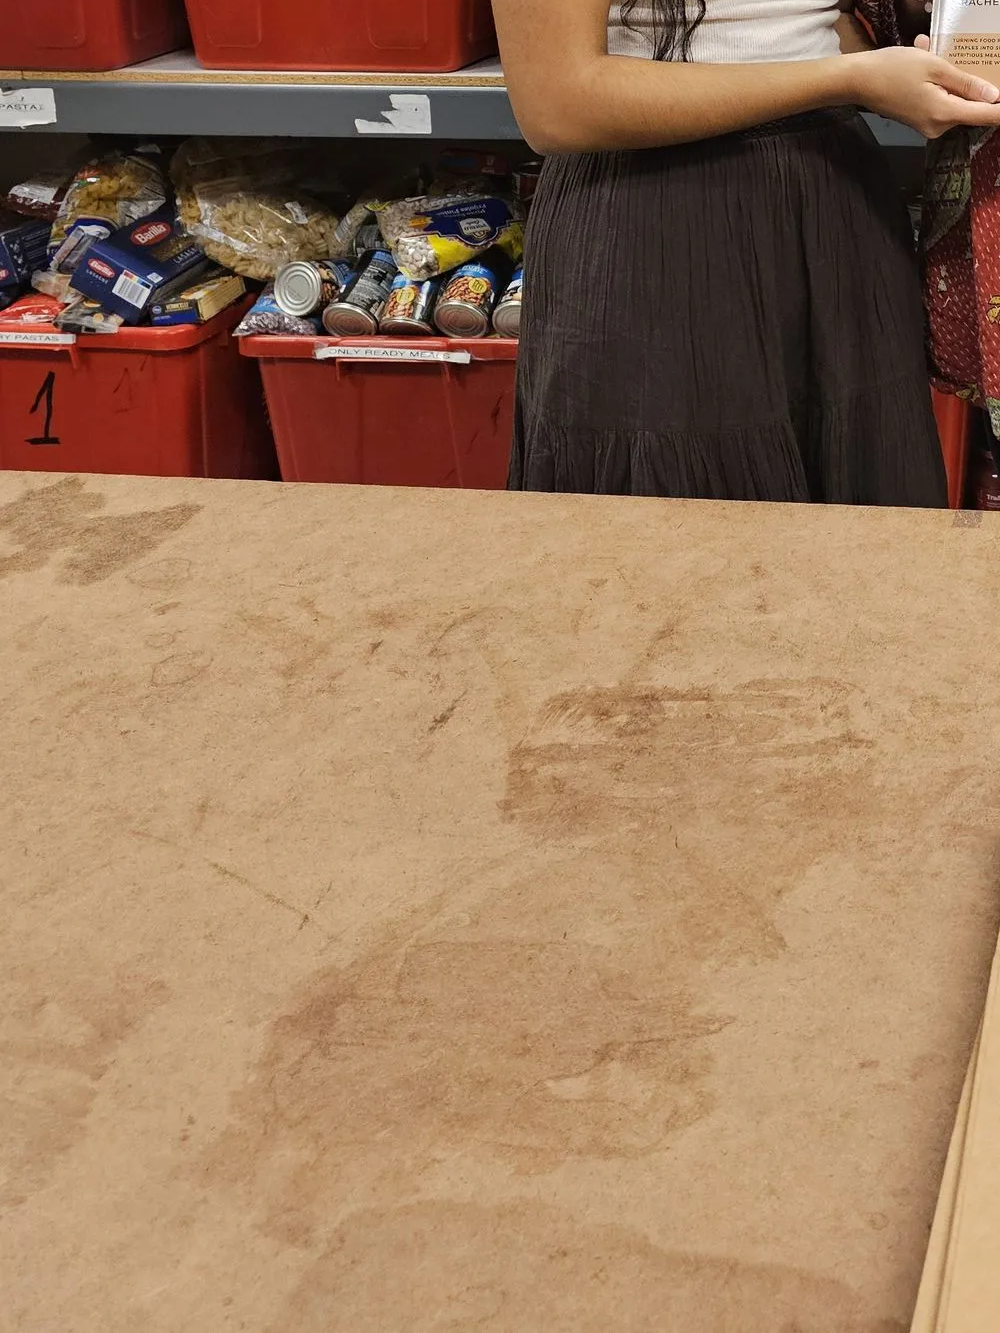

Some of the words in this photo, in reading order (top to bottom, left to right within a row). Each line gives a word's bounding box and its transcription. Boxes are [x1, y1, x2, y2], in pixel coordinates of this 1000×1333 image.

[135, 223, 168, 245] Barilla
[15, 334, 59, 342] PASTAS
[364, 349, 407, 358] READY
[24, 370, 62, 445] 1
